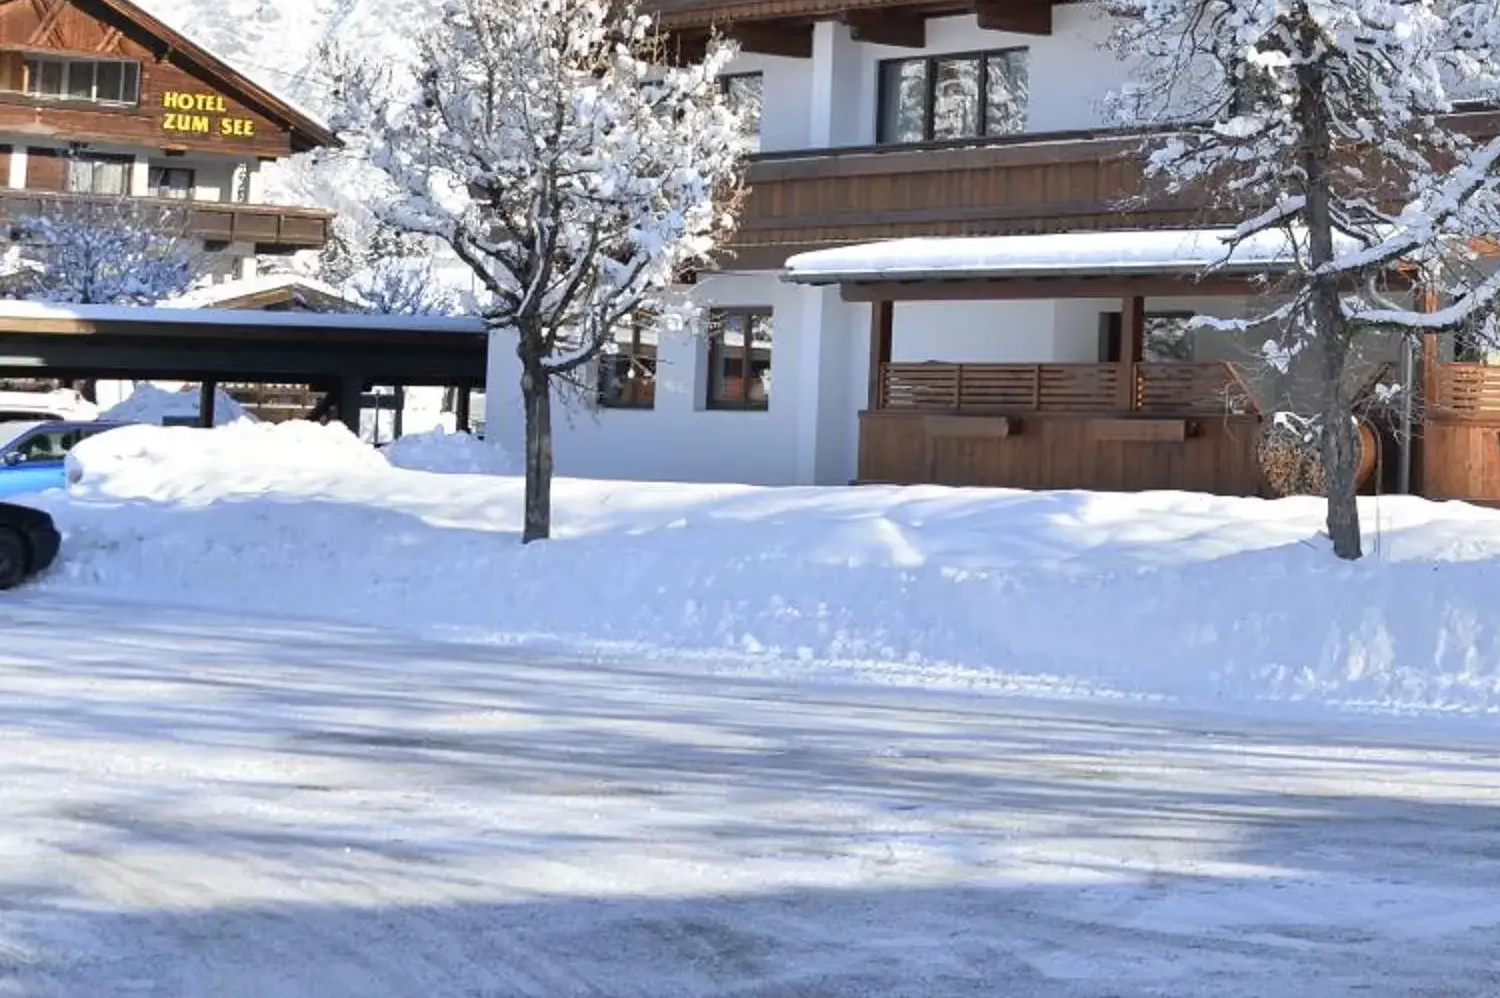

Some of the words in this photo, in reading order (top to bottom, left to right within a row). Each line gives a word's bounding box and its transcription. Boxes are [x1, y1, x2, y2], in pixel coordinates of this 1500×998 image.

[163, 91, 227, 112] HOTEL
[163, 113, 209, 133] ZUM
[221, 118, 254, 136] SEE
